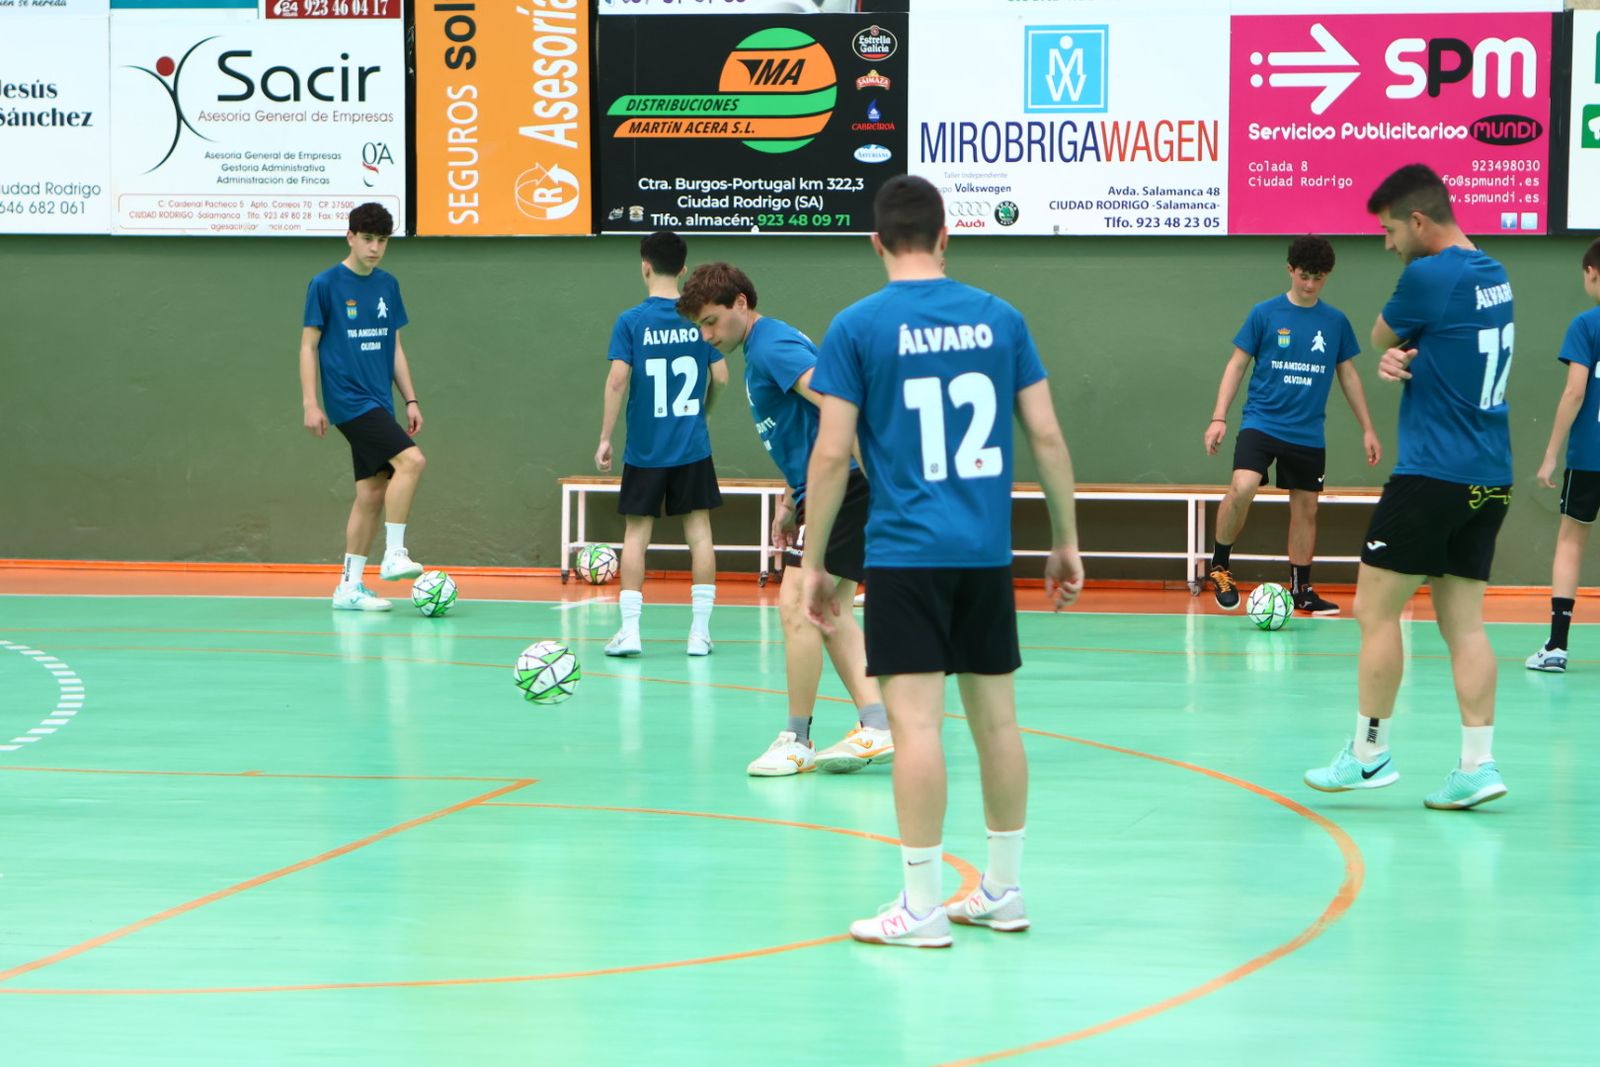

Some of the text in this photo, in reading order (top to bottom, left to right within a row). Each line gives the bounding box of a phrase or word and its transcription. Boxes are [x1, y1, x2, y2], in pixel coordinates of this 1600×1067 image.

[282, 2, 298, 12] 24
[304, 0, 389, 16] 923 46 04 17
[858, 35, 891, 45] Estrella
[860, 44, 889, 53] Galicia
[217, 50, 381, 102] Sacir
[0, 79, 58, 99] esús
[626, 99, 740, 111] DISTRIBUCIONES
[255, 110, 307, 122] General
[311, 110, 329, 122] de
[333, 110, 394, 124] Empresas
[684, 121, 729, 133] ACERA
[731, 121, 755, 133] S.L.
[1248, 121, 1537, 140] Servicios Publicitarios MUNDI
[921, 120, 1218, 163] MIROBRIGAWAGEN
[244, 151, 281, 160] General
[283, 151, 296, 160] de
[298, 151, 342, 161] Empresas
[447, 85, 479, 224] SEGUROS
[261, 163, 326, 173] Administrativa
[1249, 161, 1308, 173] Colada 8
[1472, 160, 1540, 171] 923498030
[286, 175, 299, 185] de
[301, 175, 330, 185] Fincas
[638, 178, 864, 193] Ctra. Burgos-Portugal km 322,3
[1249, 175, 1353, 189] Ciudad Rodrigo
[1442, 175, 1540, 188] fo@spmundi.es
[45, 181, 101, 199] Rodrigo
[533, 187, 562, 203] R
[955, 183, 1012, 195] Volkswagen
[1108, 186, 1220, 196] Avda. Salamanca 48
[205, 200, 238, 208] Pacheco
[677, 196, 824, 211] Ciudad Rodrigo (SA)
[1449, 191, 1540, 205] w.spmundi.es
[29, 201, 55, 214] 682
[60, 201, 85, 214] 061
[1049, 200, 1094, 210] CIUDAD
[1096, 200, 1149, 210] RODRIGO
[129, 211, 157, 219] CIUDAD
[159, 211, 194, 219] RODRIGO
[651, 213, 682, 226] Tlfo.
[686, 213, 754, 226] almacén:
[757, 214, 784, 226] 923
[788, 214, 808, 226] 48
[812, 214, 832, 226] 09
[836, 214, 850, 226] 71
[955, 218, 985, 228] Audi
[1104, 217, 1220, 228] Tlfo. 923 48 23 05
[643, 327, 699, 345] ÁLVARO
[898, 323, 993, 356] ÁLVARO
[1271, 360, 1283, 369] TUS
[1284, 361, 1310, 371] AMIGOS
[1478, 322, 1514, 410] 12
[645, 356, 700, 418] 12
[1284, 375, 1312, 386] OLVIDAN
[903, 372, 1003, 482] 12
